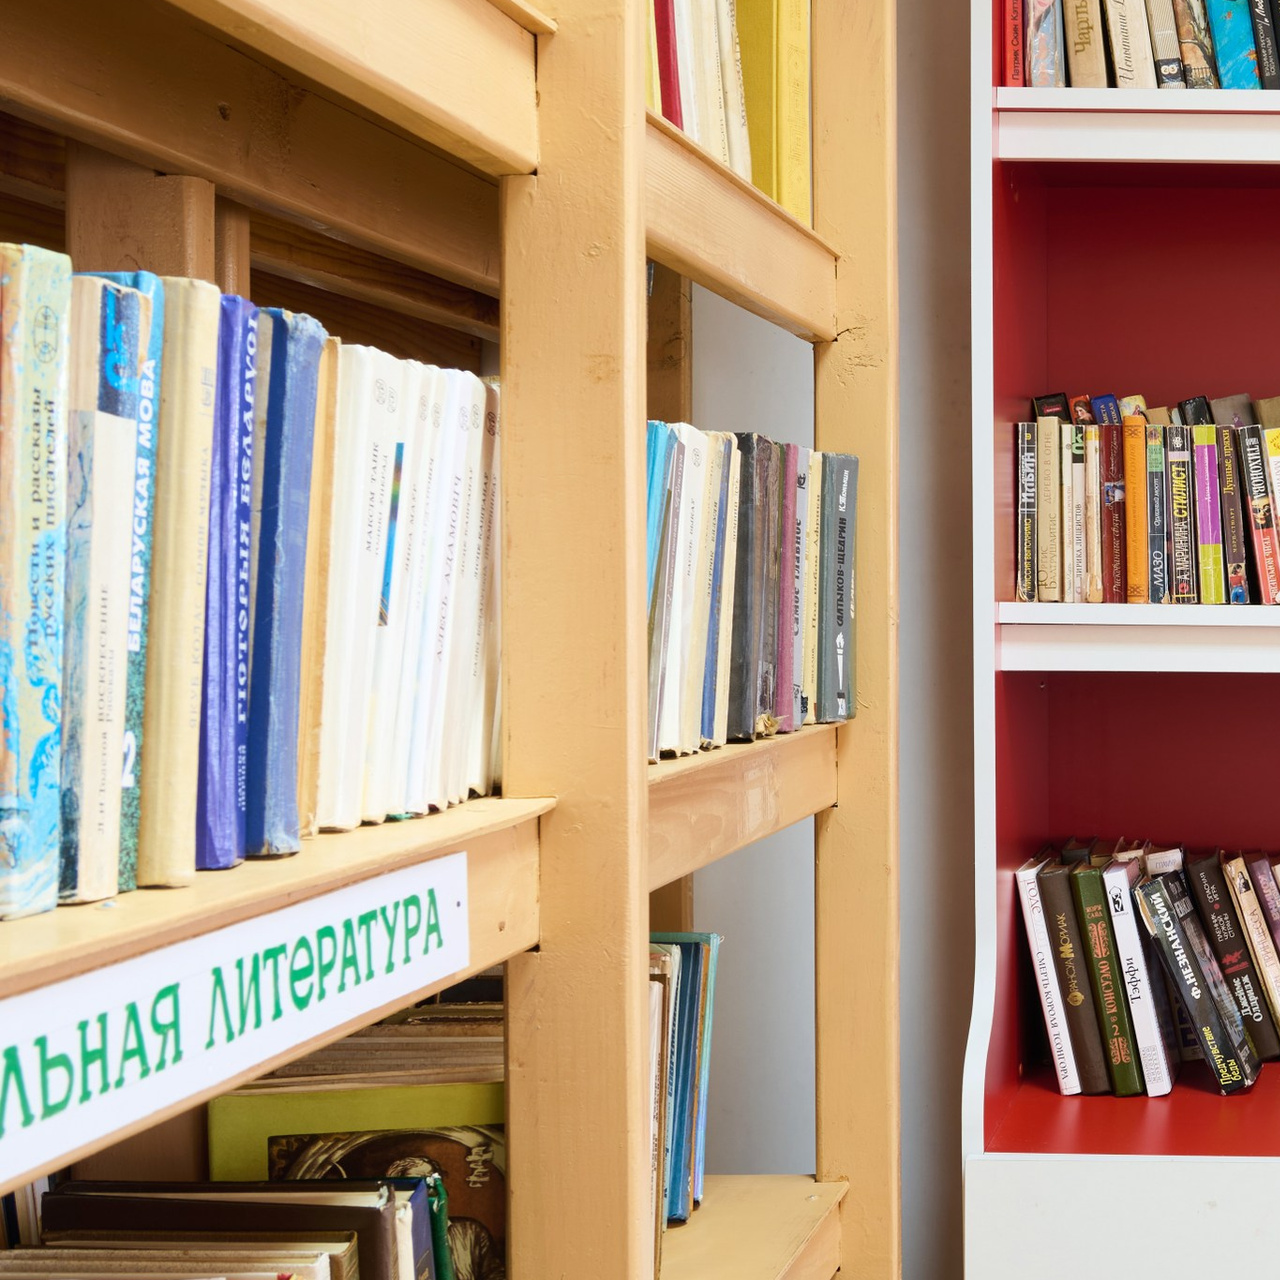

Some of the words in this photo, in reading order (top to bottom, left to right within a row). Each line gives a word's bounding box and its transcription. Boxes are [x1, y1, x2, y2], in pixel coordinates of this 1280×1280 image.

[1011, 24, 1019, 46] Скин
[1012, 50, 1020, 80] Патрик
[28, 387, 43, 504] рассказы
[43, 399, 57, 525] писателей
[370, 441, 379, 483] ТАНК
[1044, 431, 1052, 456] ОГНЕ
[1222, 429, 1233, 458] пряхи
[1021, 452, 1036, 503] ИЛЬИН
[1044, 469, 1052, 504] ДЕРЕВО
[1171, 465, 1188, 518] СТИЛИСТ
[1224, 459, 1235, 495] Лунные
[29, 516, 41, 531] и
[126, 456, 145, 652] БЕЛАРУСКАЯ
[138, 357, 157, 449] МОВА
[365, 492, 378, 552] МАКСІМ
[1111, 513, 1120, 536] связи
[1037, 546, 1047, 586] ЮРГИС
[1113, 539, 1122, 593] Рискованные
[1174, 520, 1189, 570] МАРИНИНА
[435, 596, 448, 661] АЛЕСЬ
[443, 474, 462, 582] АДАМОВІЧ
[836, 518, 848, 627] САЛТЫКОВ-ЩЕДРИН
[1177, 571, 1189, 580] А.
[27, 543, 42, 647] Повести
[44, 540, 58, 639] русских
[1199, 872, 1214, 903] ОПАСНАЯ
[1210, 913, 1224, 942] ПЛЕННИК
[1217, 915, 1229, 940] ЧУЖОЙ
[1223, 912, 1235, 938] СТРАНЫ
[1124, 957, 1141, 1005] Тэффи
[1233, 977, 1253, 1017] Джеймс
[1242, 974, 1264, 1022] Олдридж
[1036, 951, 1050, 990] СМЕРТЬ
[1044, 990, 1058, 1029] КОРОЛЯ
[1052, 1032, 1069, 1080] ТСОНГОРА
[1200, 1026, 1233, 1086] Предчувствие
[1226, 1058, 1242, 1080] беды
